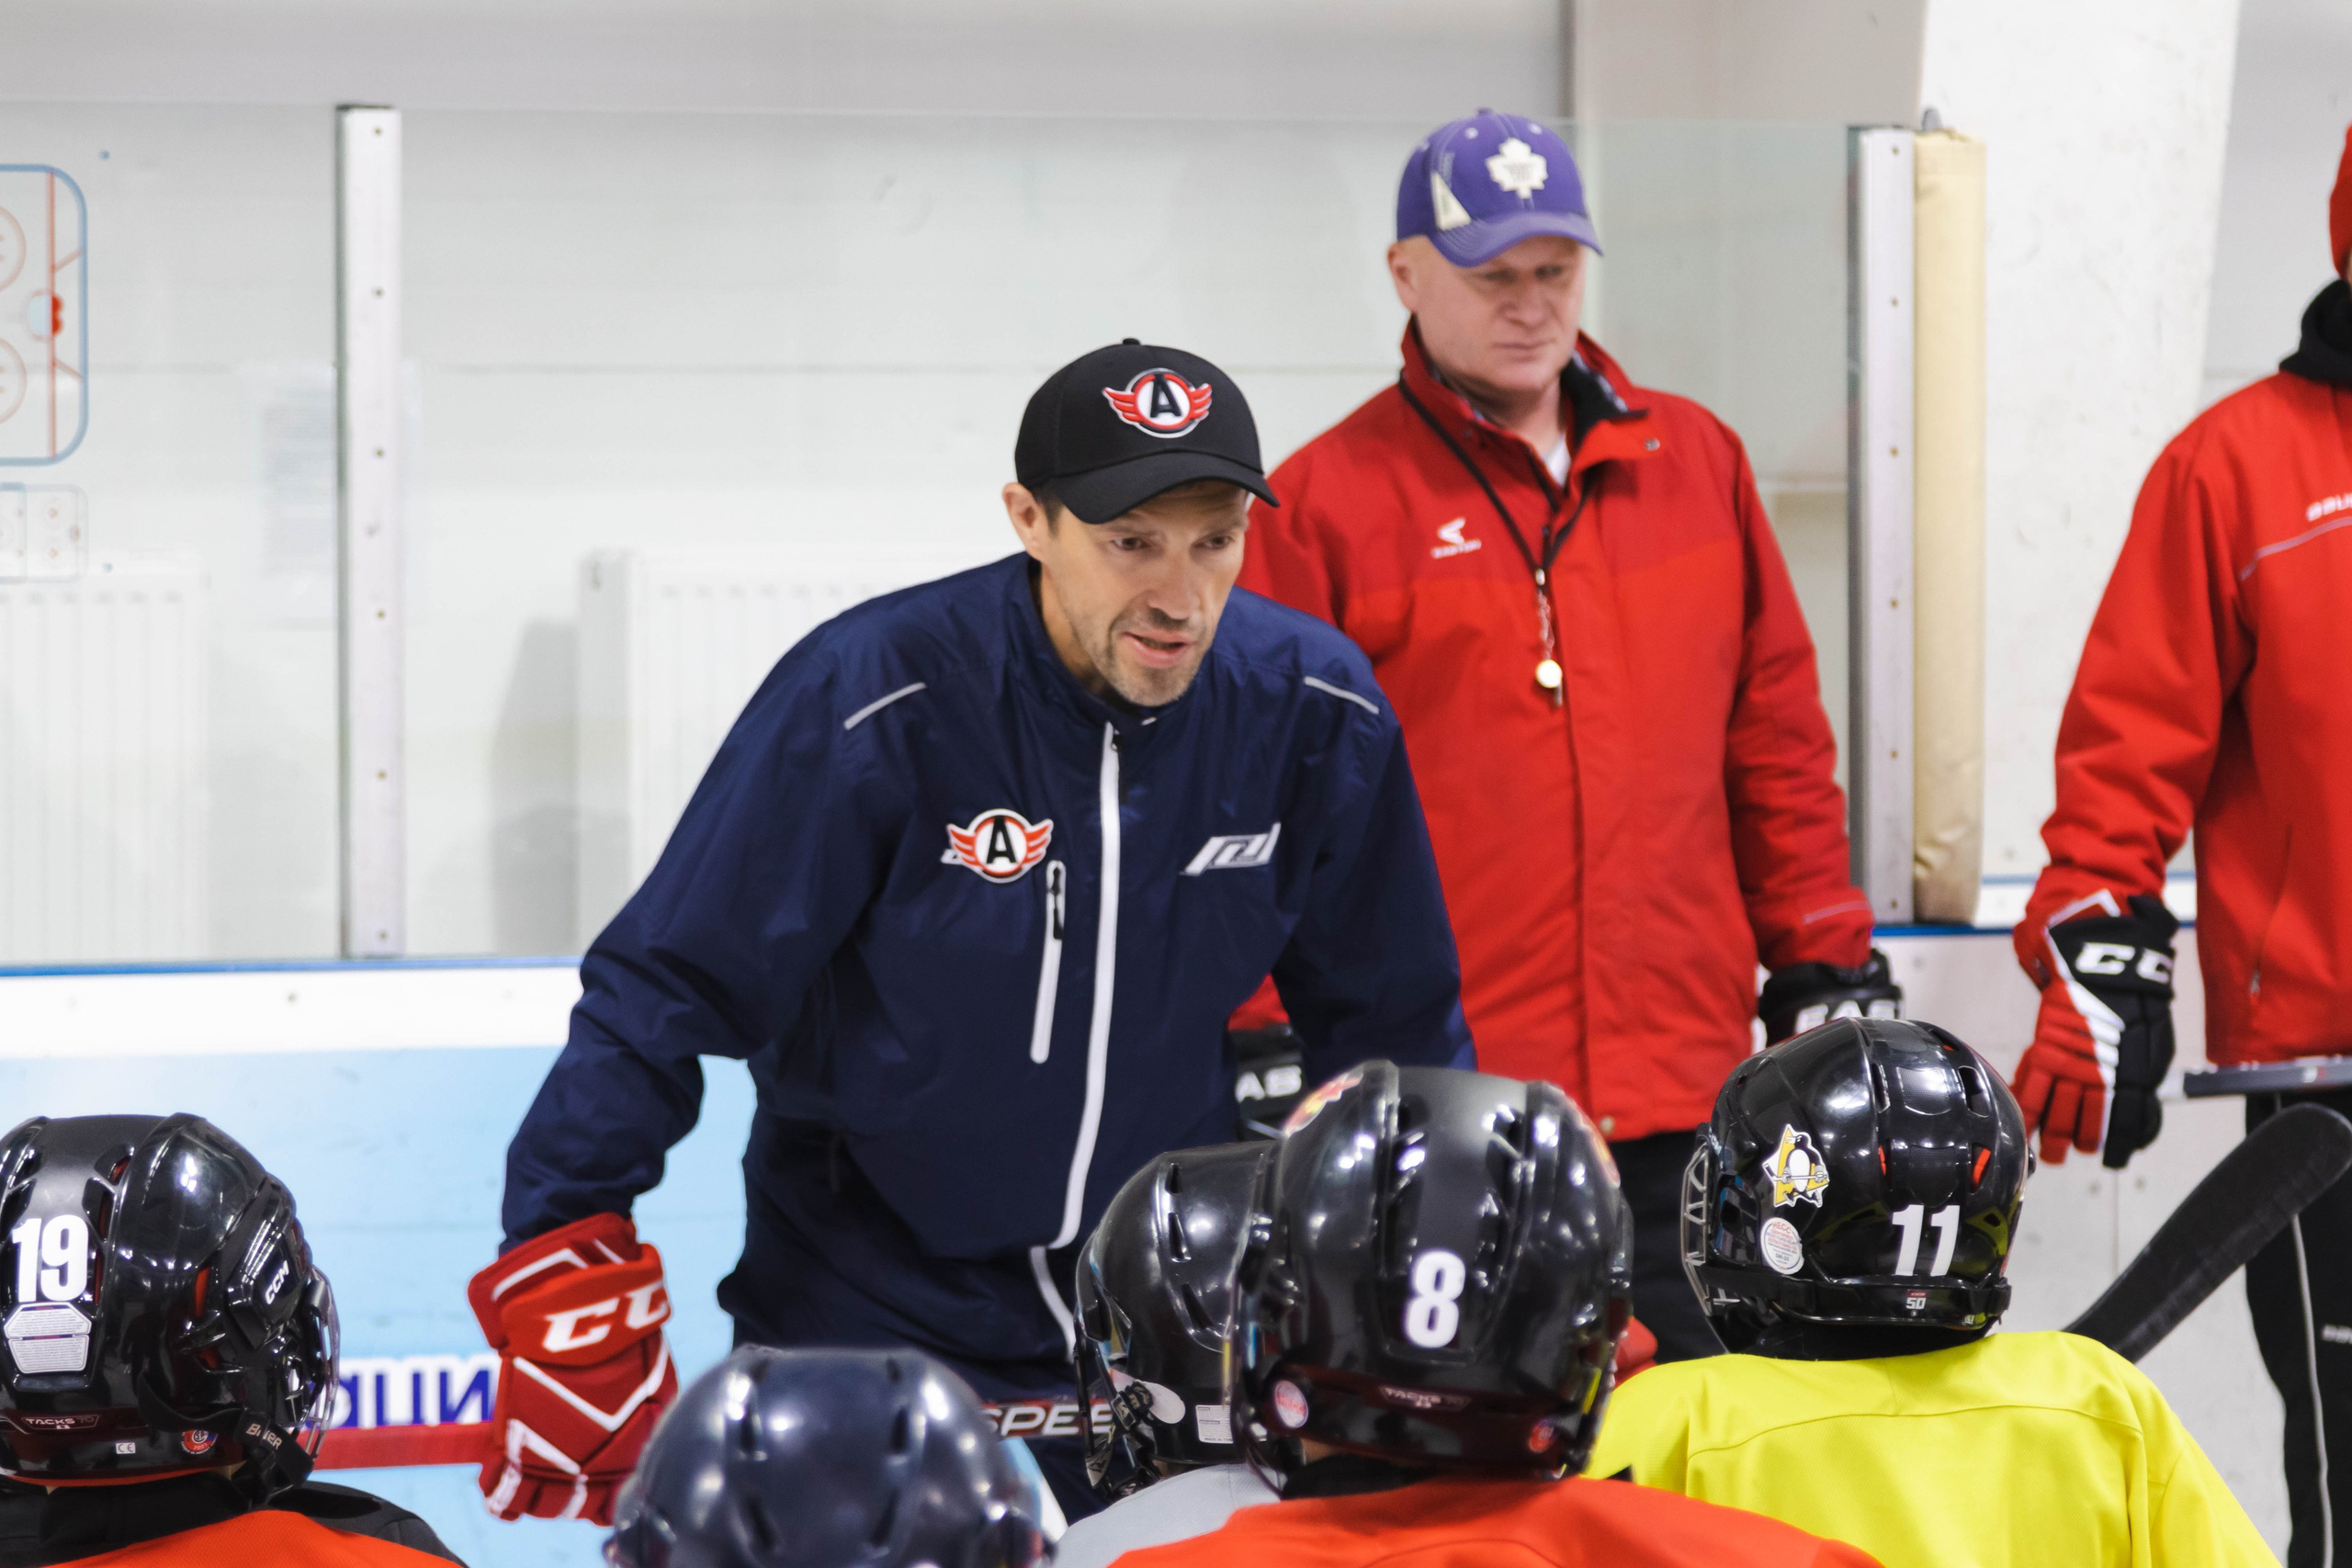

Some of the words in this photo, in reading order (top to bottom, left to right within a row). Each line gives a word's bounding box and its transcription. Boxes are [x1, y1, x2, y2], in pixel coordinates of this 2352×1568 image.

[11, 1214, 89, 1303] 19
[1892, 1204, 1961, 1277] 11
[265, 1259, 289, 1304] CCM
[1407, 1250, 1465, 1348] 8
[1905, 1297, 1927, 1310] 50
